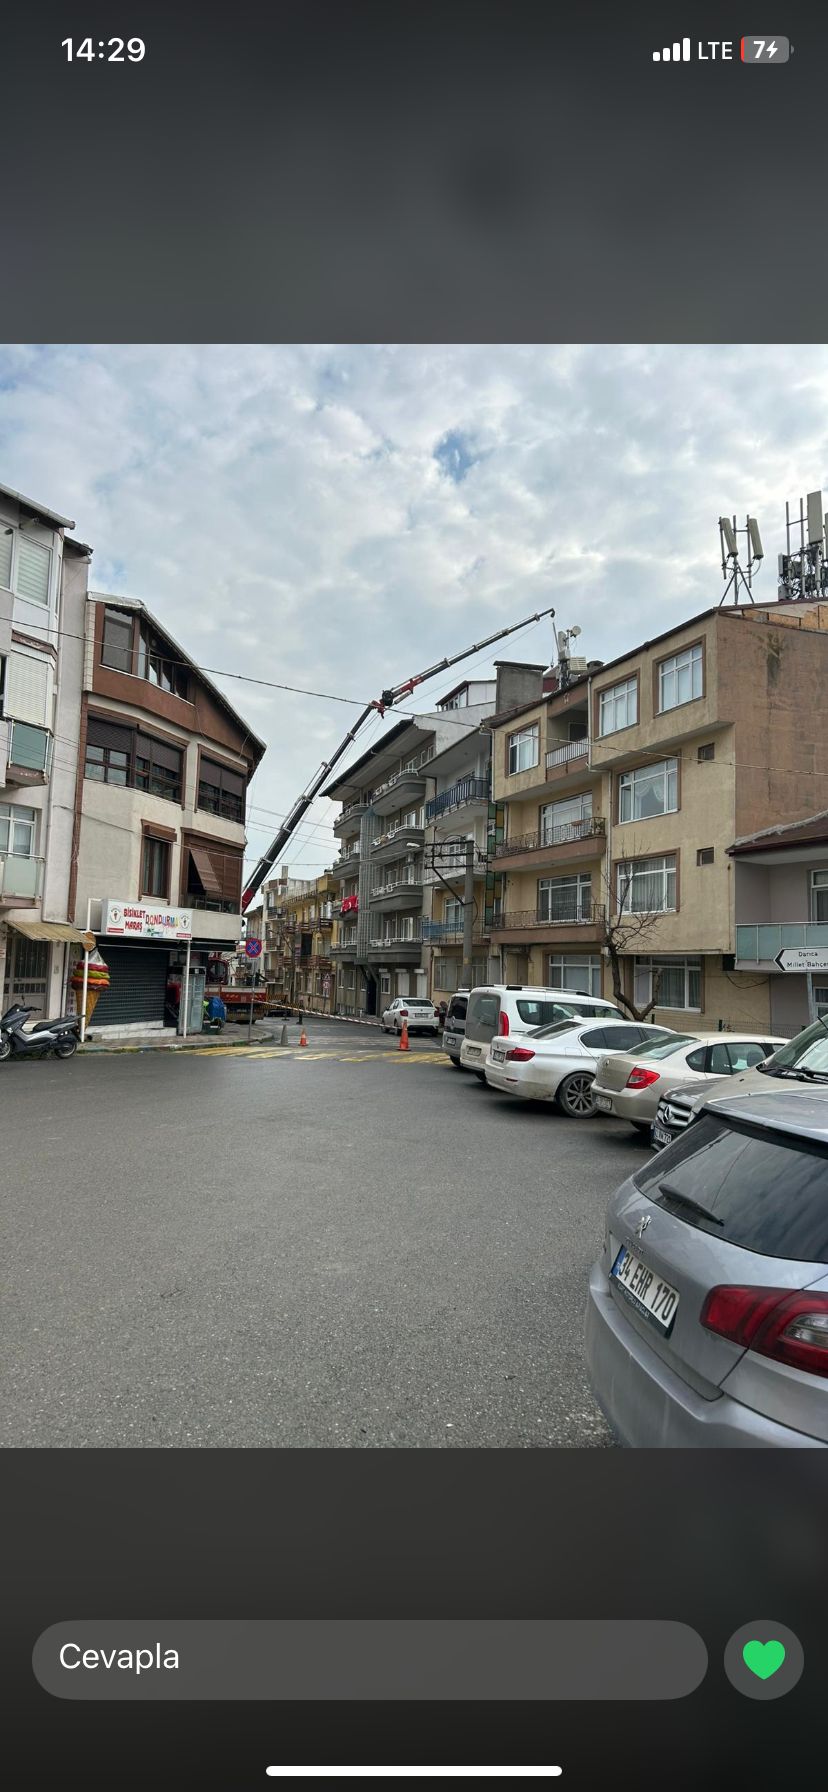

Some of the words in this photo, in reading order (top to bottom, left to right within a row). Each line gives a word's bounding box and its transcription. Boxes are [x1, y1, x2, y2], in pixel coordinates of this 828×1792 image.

[145, 914, 179, 928] DONDURMA
[619, 1252, 634, 1281] 34
[629, 1262, 654, 1301] EHR
[650, 1282, 676, 1321] 170
